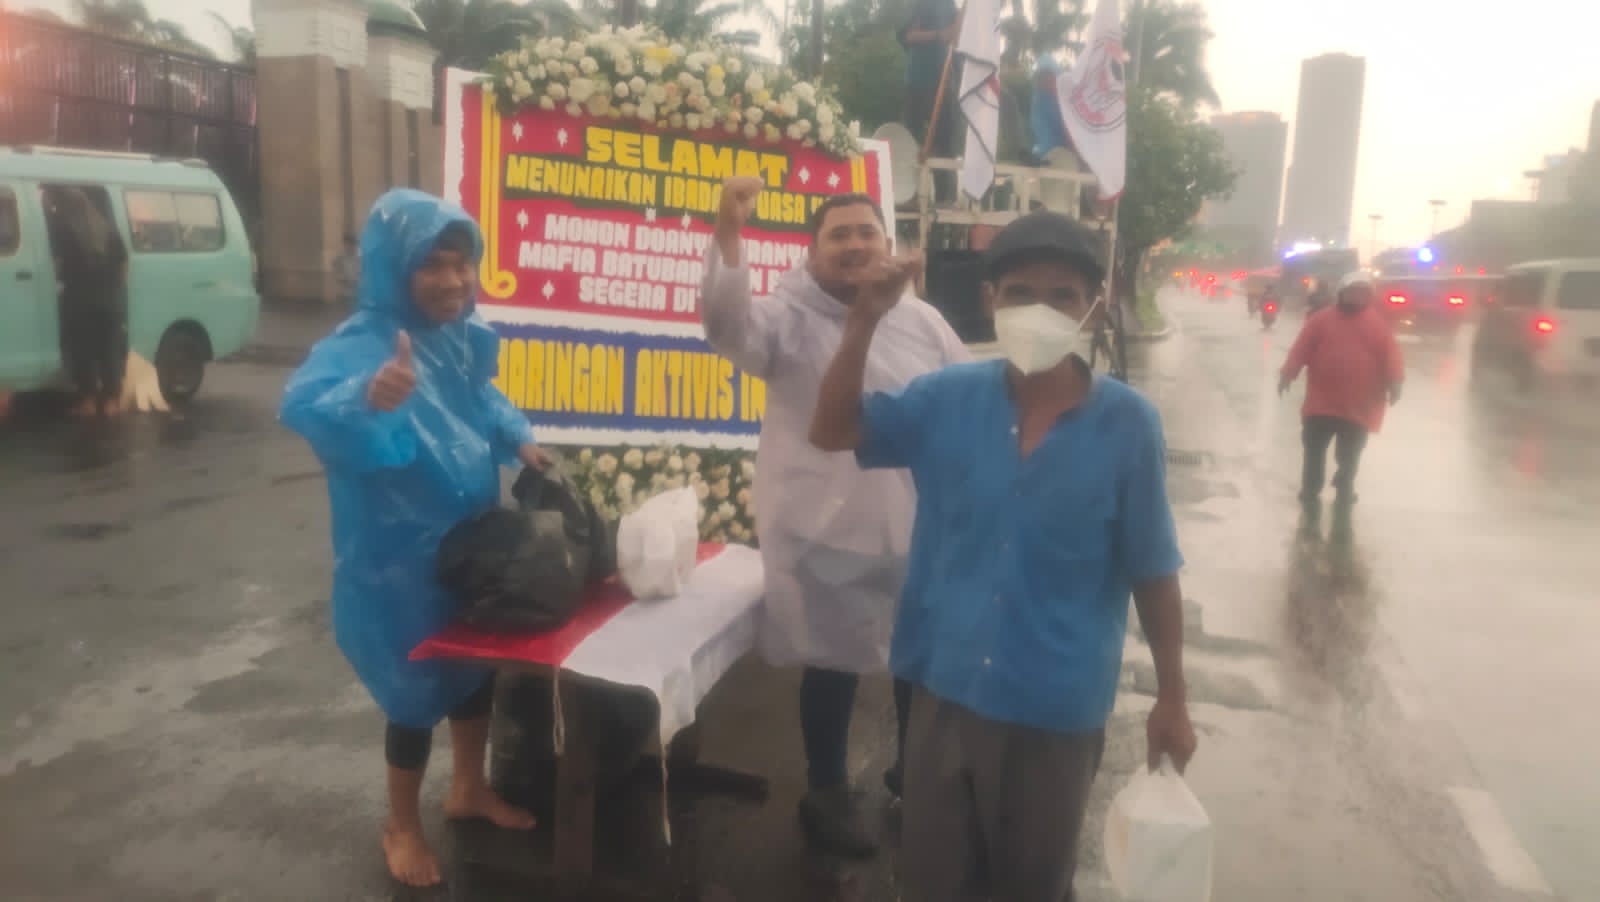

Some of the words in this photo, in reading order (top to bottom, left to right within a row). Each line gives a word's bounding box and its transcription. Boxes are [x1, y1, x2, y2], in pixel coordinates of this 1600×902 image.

[586, 126, 788, 187] SELAMAT
[506, 153, 657, 207] MENUNAIKAN
[664, 175, 723, 213] IBADA
[757, 191, 805, 224] UASA
[544, 213, 631, 249] MOHON
[518, 241, 597, 274] MAFIA
[602, 249, 704, 286] BATUBAR
[578, 276, 667, 312] SEGERA
[491, 337, 624, 416] JARINGAN
[634, 348, 734, 421] AKTIVIS
